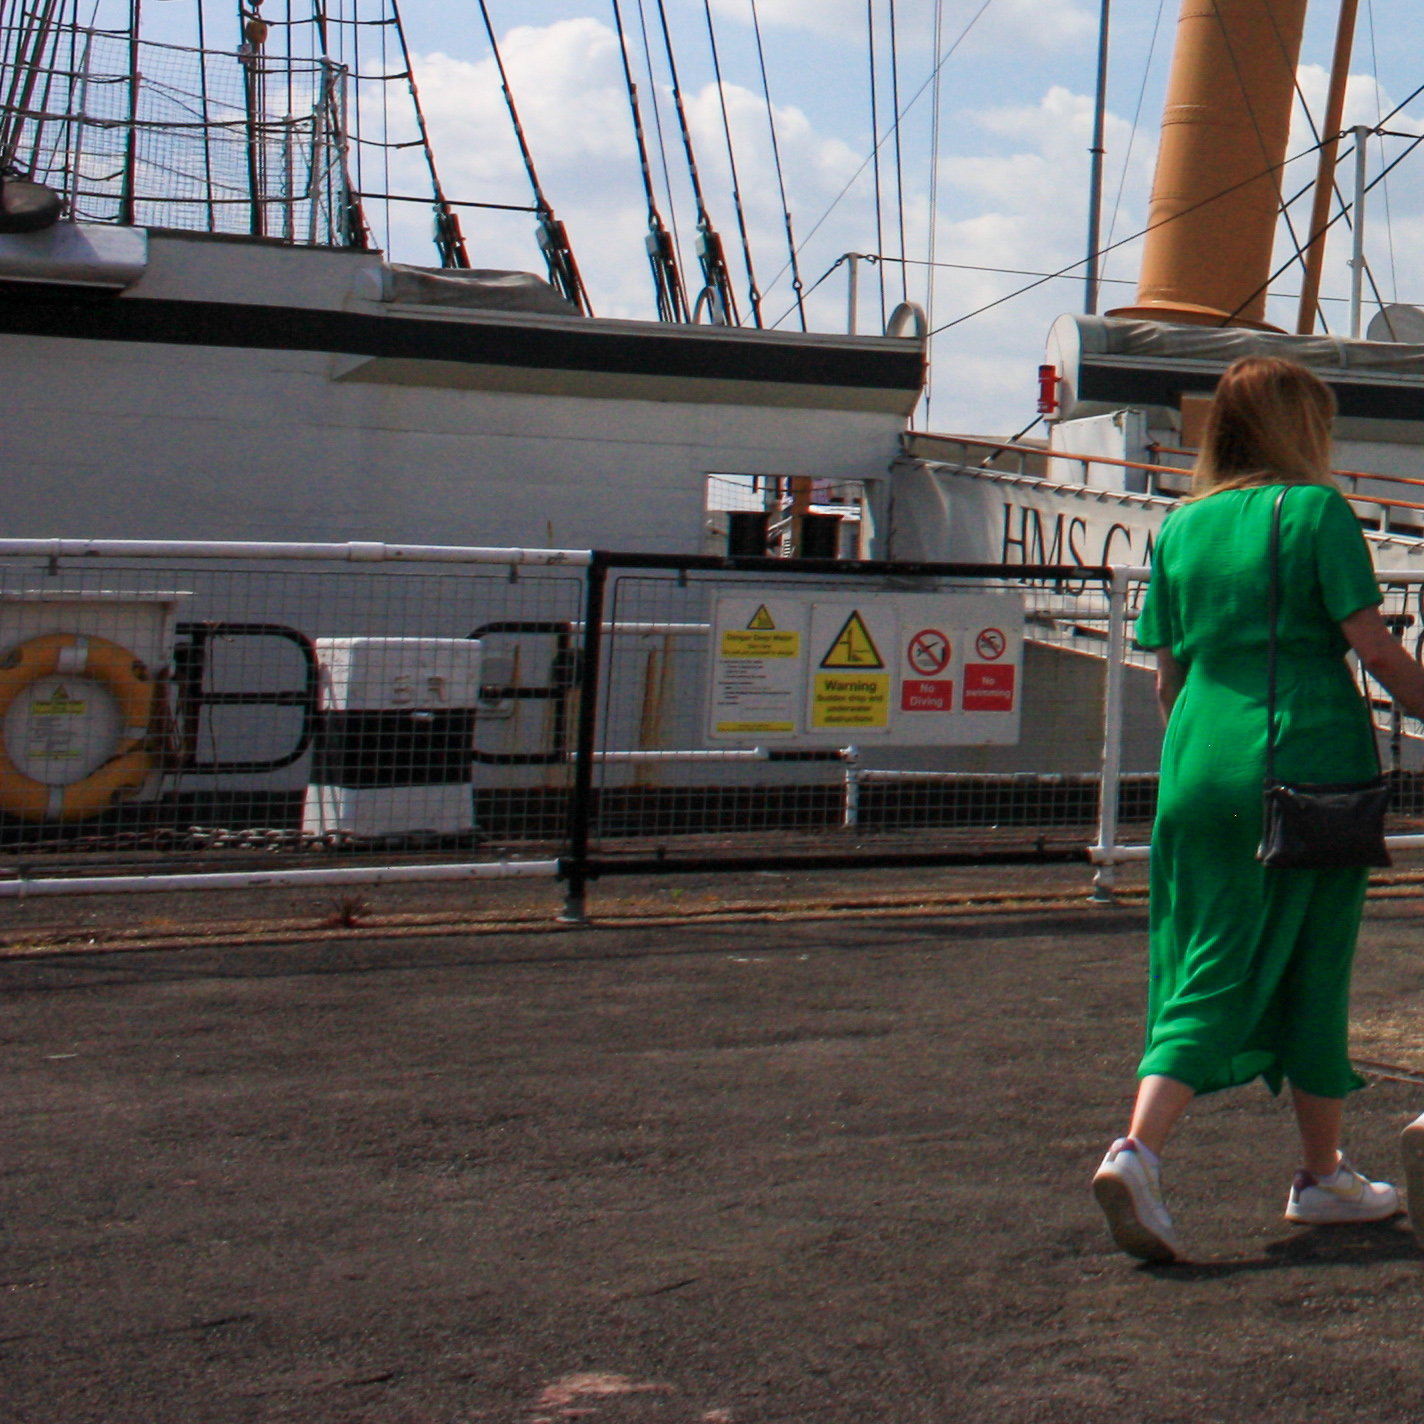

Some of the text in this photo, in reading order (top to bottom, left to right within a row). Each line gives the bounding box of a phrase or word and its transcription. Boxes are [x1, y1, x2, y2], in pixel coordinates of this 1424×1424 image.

[1002, 503, 1087, 596] HMS
[982, 676, 995, 685] No
[824, 680, 877, 693] Warning
[920, 683, 935, 692] No
[869, 693, 883, 702] and
[965, 689, 1011, 699] swimming
[910, 696, 943, 708] Diving
